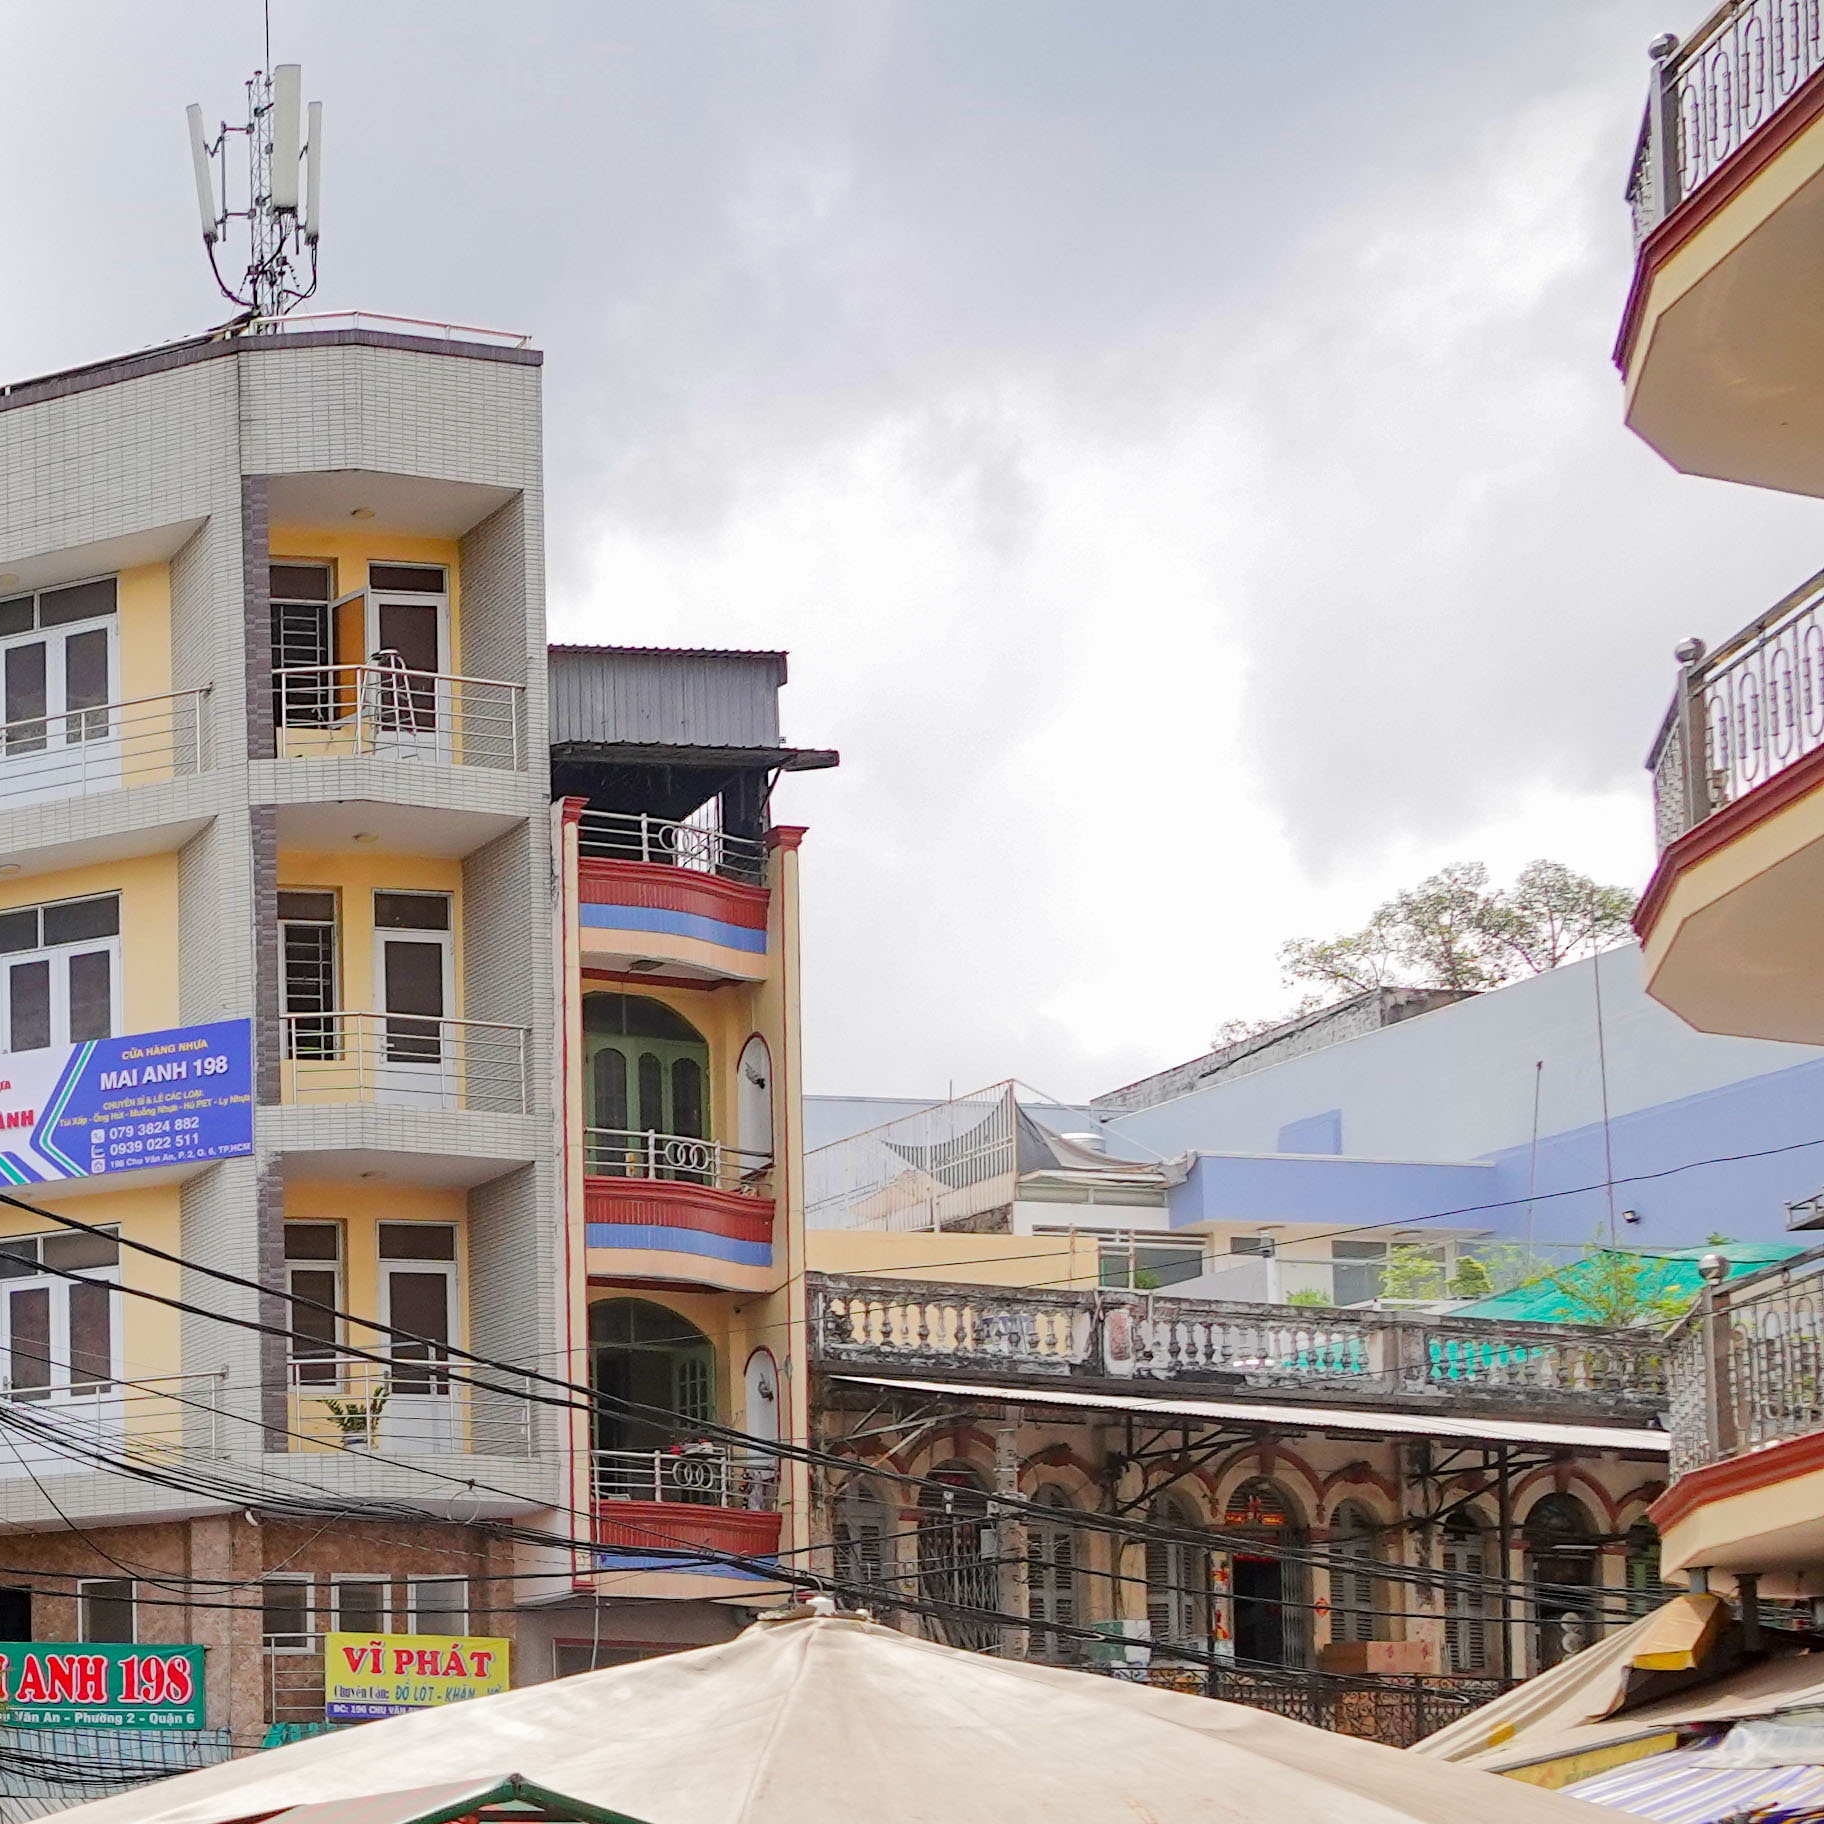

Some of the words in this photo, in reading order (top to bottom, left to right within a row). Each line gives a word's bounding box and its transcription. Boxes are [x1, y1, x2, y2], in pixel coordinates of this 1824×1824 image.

[121, 1045, 144, 1061] CỬA
[146, 1043, 176, 1057] HÀNG
[178, 1038, 209, 1053] NHỰA
[100, 1069, 138, 1092] MAI
[142, 1061, 187, 1085] ANH
[193, 1055, 230, 1077] 198
[109, 1125, 134, 1140] 079
[138, 1121, 171, 1137] 3824
[174, 1116, 200, 1132] 882
[110, 1140, 143, 1156] 0939
[146, 1136, 172, 1151] 022
[175, 1132, 199, 1147] 511
[342, 1640, 386, 1676] VĨ
[393, 1643, 497, 1678] PHÁT
[16, 1653, 108, 1704] ANH
[118, 1654, 194, 1706] 198
[43, 1712, 61, 1724] An
[75, 1711, 123, 1726] Phường
[126, 1713, 135, 1724] 2
[149, 1713, 183, 1727] Quận
[186, 1713, 196, 1724] 6
